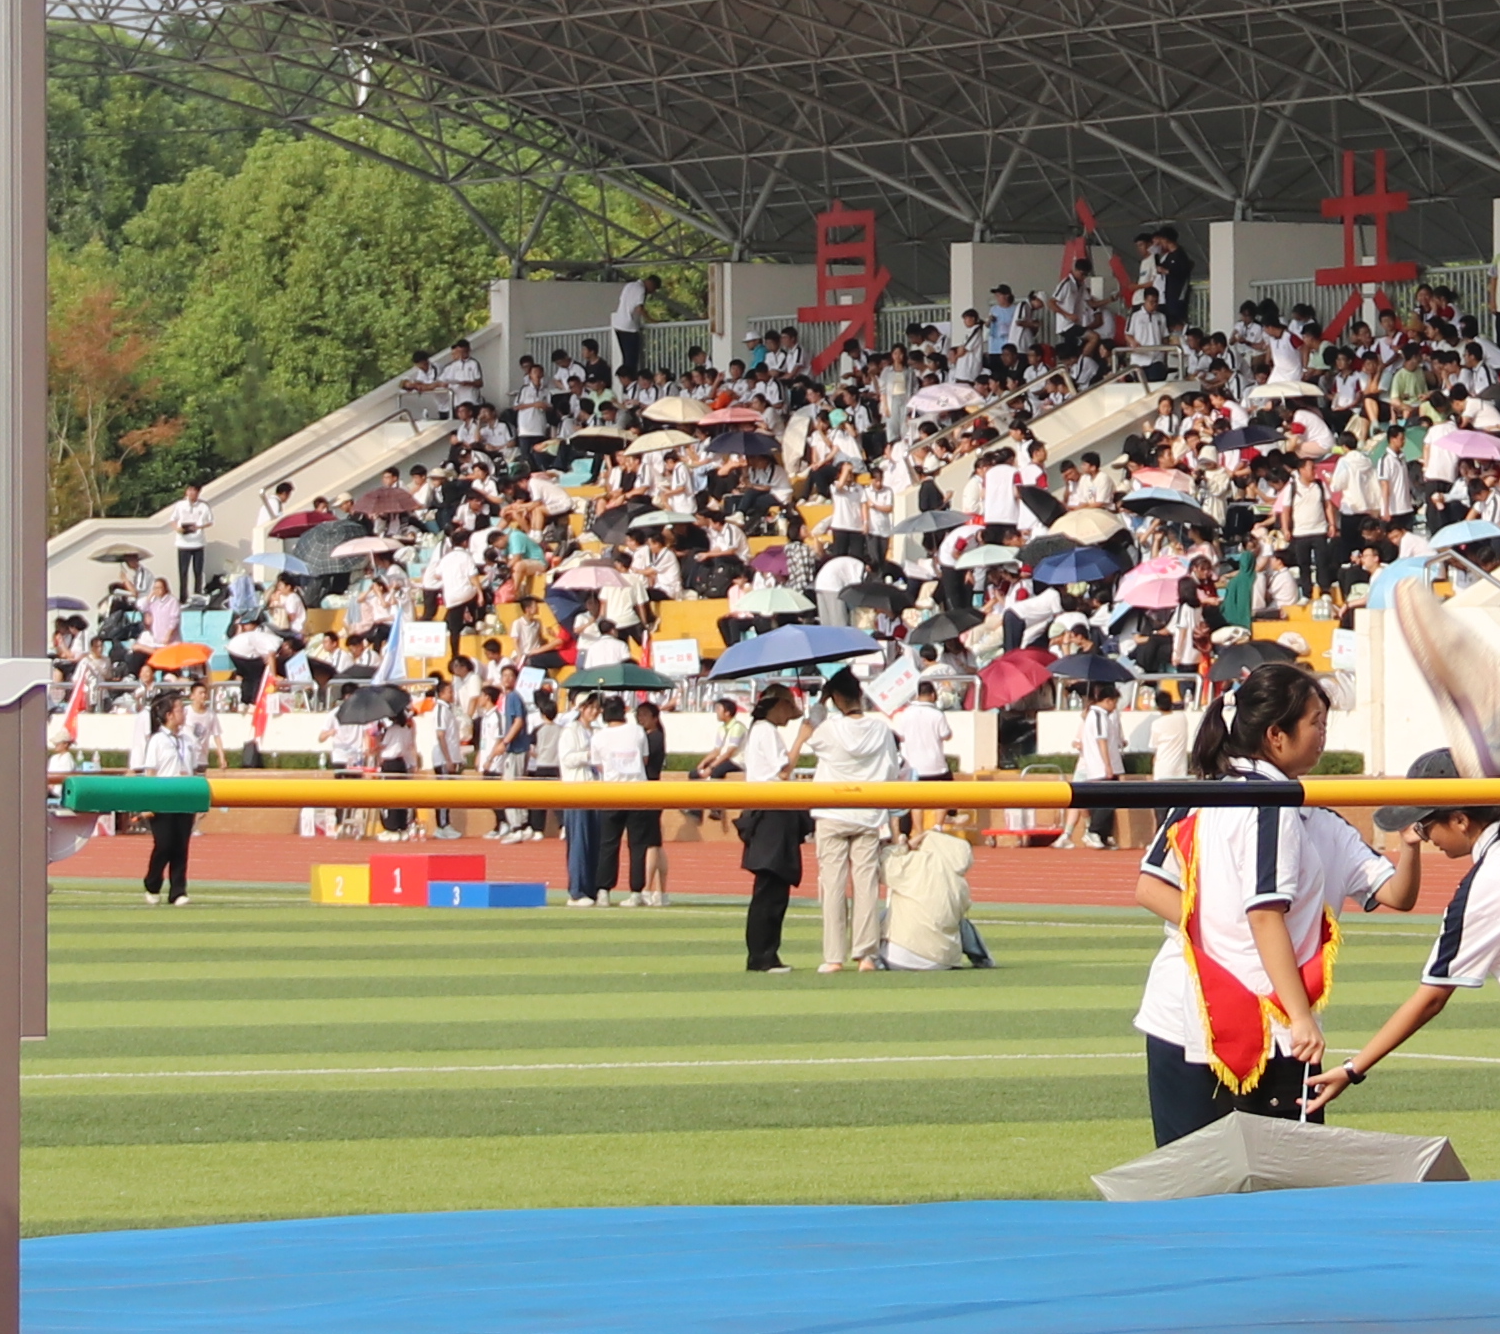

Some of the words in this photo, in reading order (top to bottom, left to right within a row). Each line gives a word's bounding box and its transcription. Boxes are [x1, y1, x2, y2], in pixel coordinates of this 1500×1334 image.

[334, 875, 344, 898] 2
[393, 868, 403, 894] 1
[452, 885, 462, 906] 3
